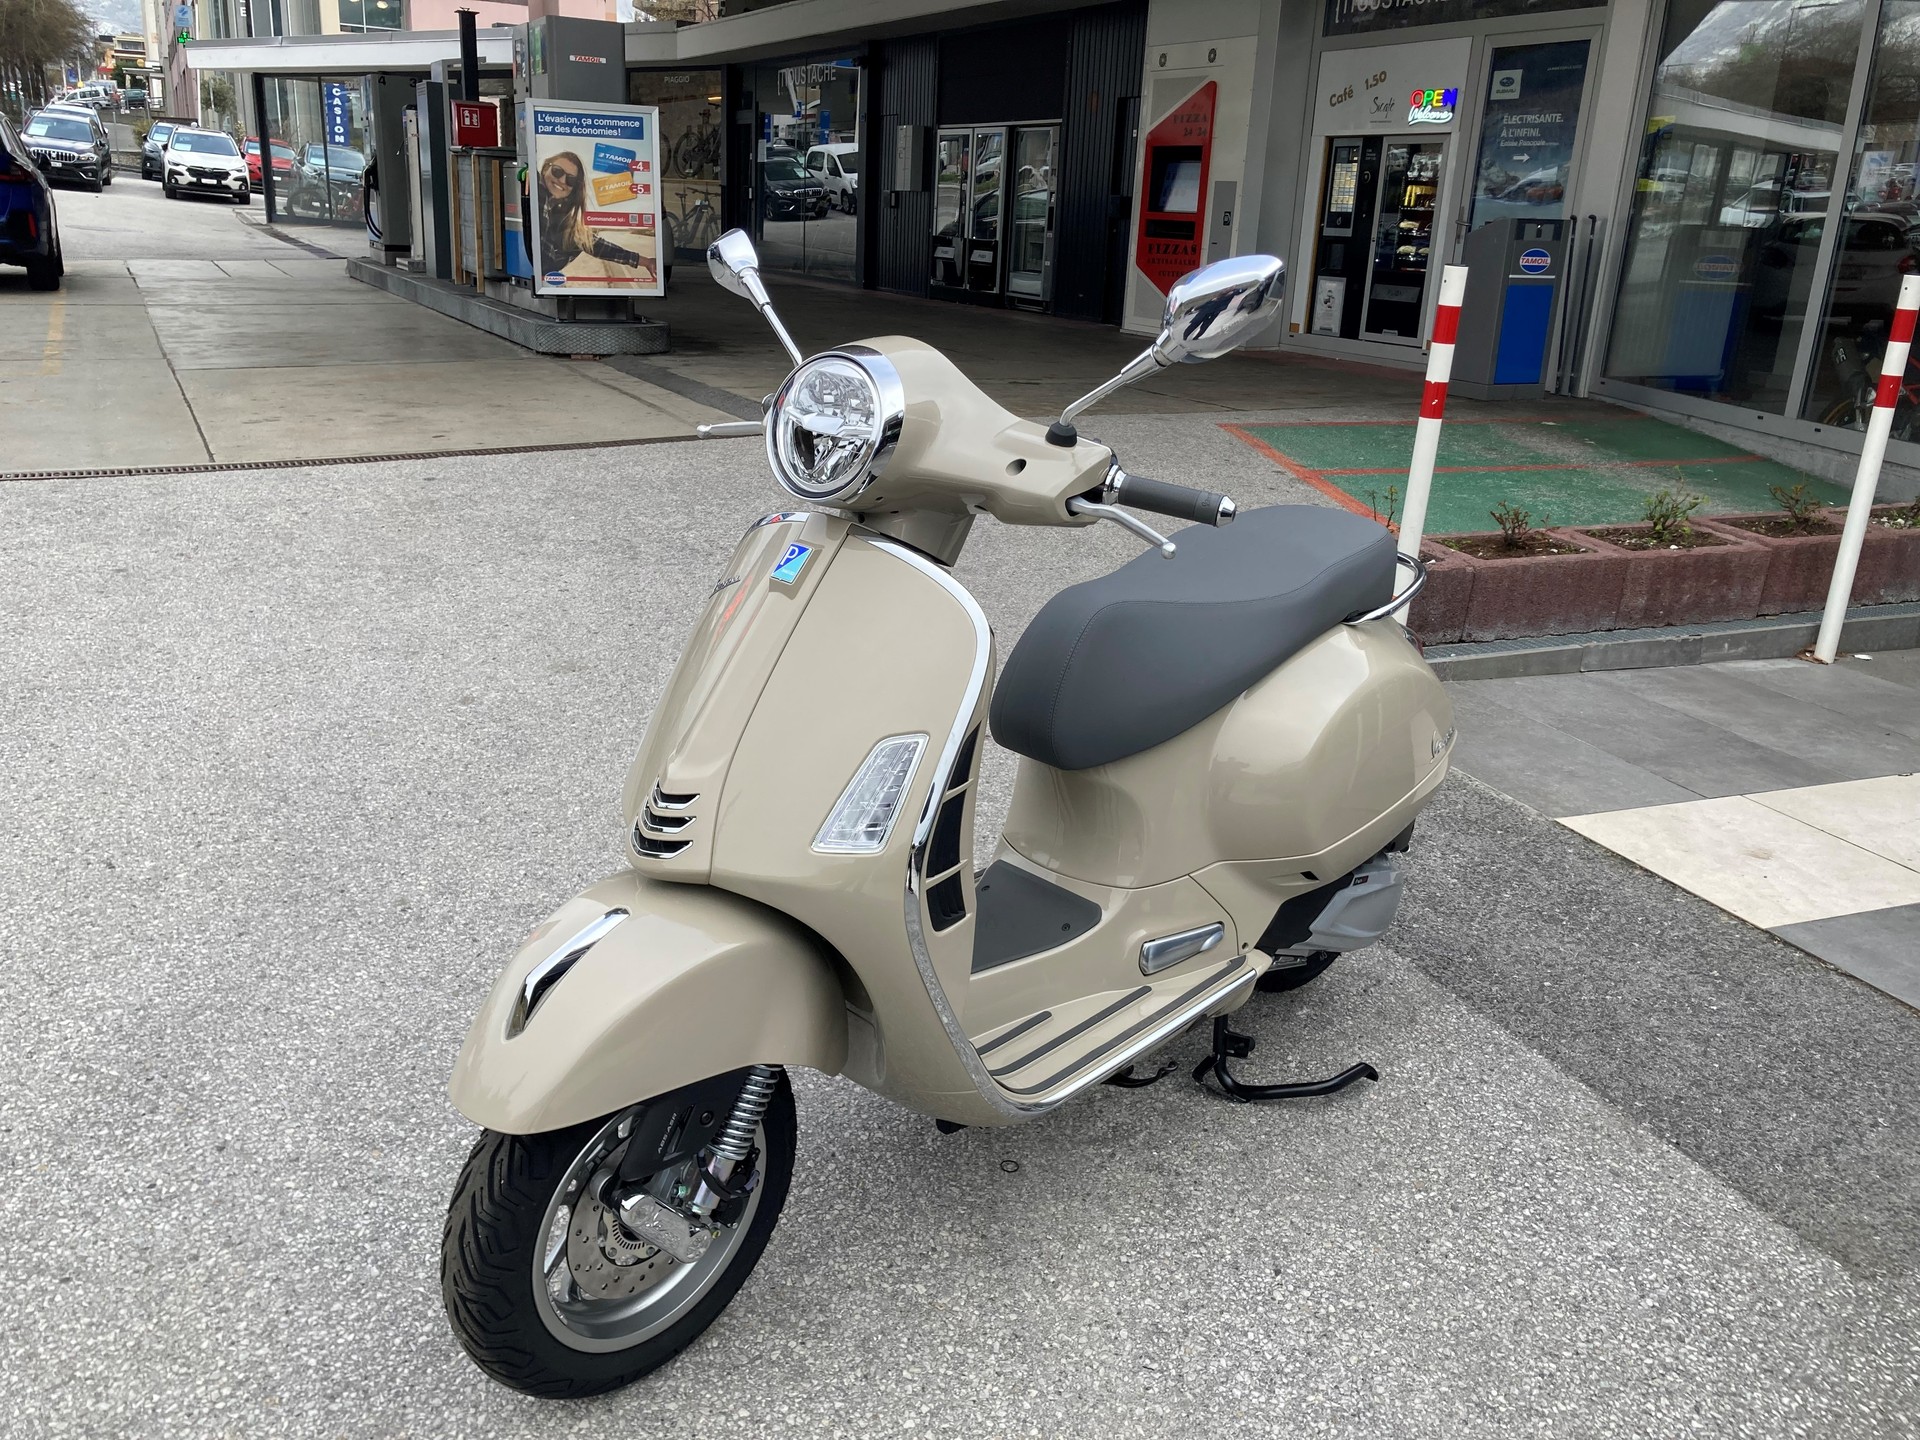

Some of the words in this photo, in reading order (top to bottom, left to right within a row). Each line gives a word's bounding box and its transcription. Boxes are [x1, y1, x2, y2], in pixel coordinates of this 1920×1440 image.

[378, 75, 387, 86] 4
[663, 75, 690, 84] PIAGGIO
[1329, 85, 1354, 108] Café
[1364, 70, 1387, 91] 1.50
[1410, 87, 1458, 108] OPEN
[332, 82, 345, 143] CASION
[1408, 104, 1453, 126] Welcome
[1503, 112, 1564, 124] ÉLECTRISANTE.
[537, 113, 580, 126] L'évasion,
[581, 117, 592, 127] ça
[593, 118, 640, 128] commence
[538, 124, 553, 134] par
[554, 124, 570, 134] des
[571, 125, 621, 136] économies!
[1500, 126, 1507, 138] À
[1508, 127, 1541, 137] L'INFINI.
[1521, 257, 1549, 265] TAMOIL
